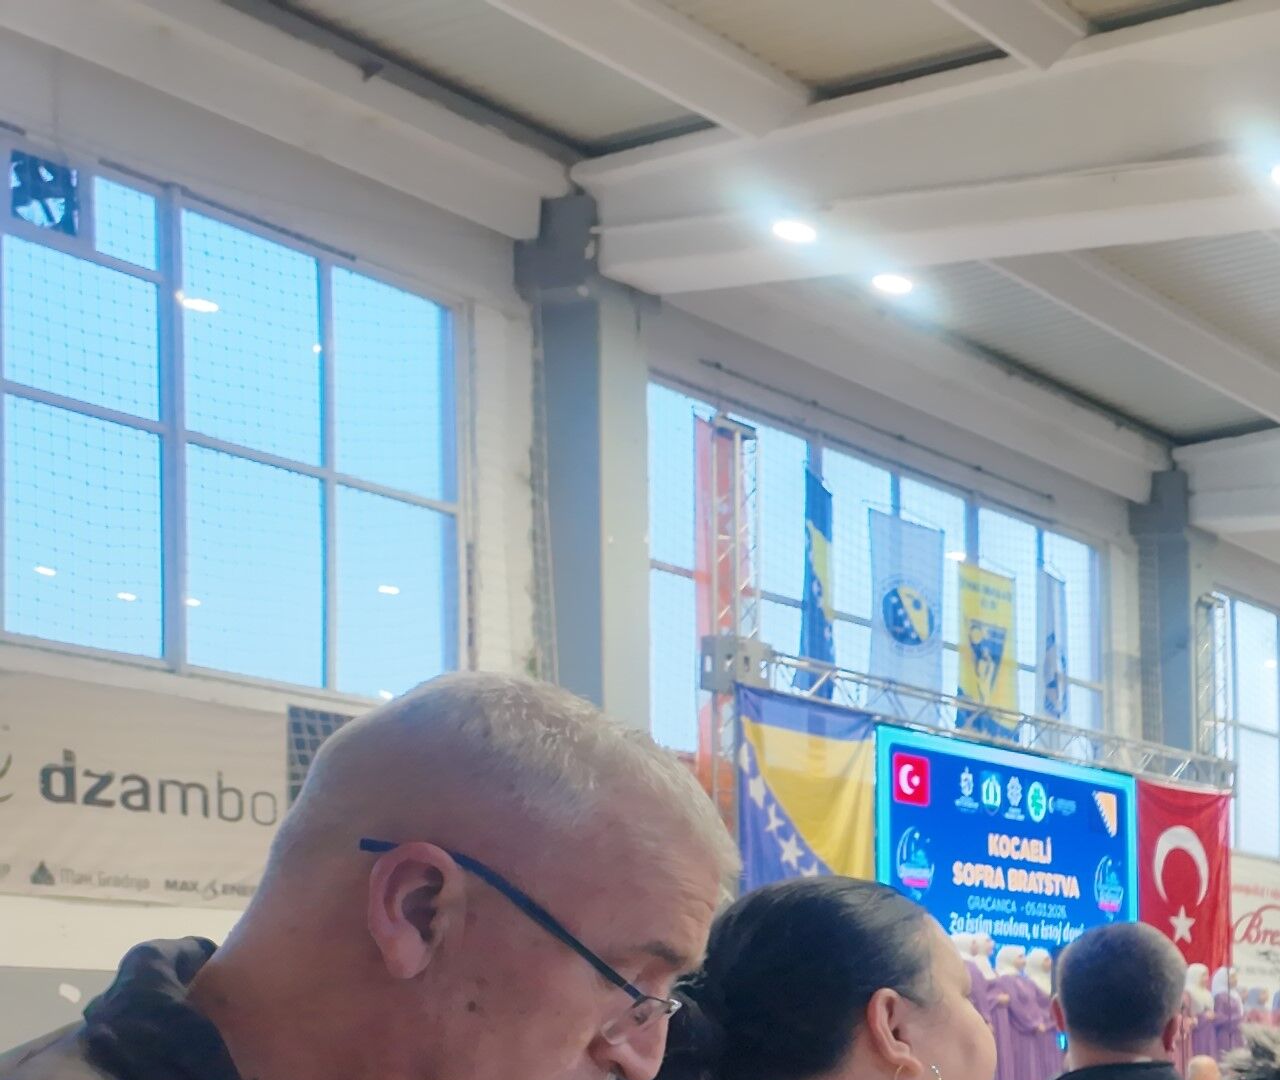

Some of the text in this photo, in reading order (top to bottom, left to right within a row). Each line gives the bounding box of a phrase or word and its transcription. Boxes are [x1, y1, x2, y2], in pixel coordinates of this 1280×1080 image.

[39, 749, 278, 826] dzambo
[952, 860, 1005, 890] SOFRA
[1007, 867, 1080, 899] BRATSTVA
